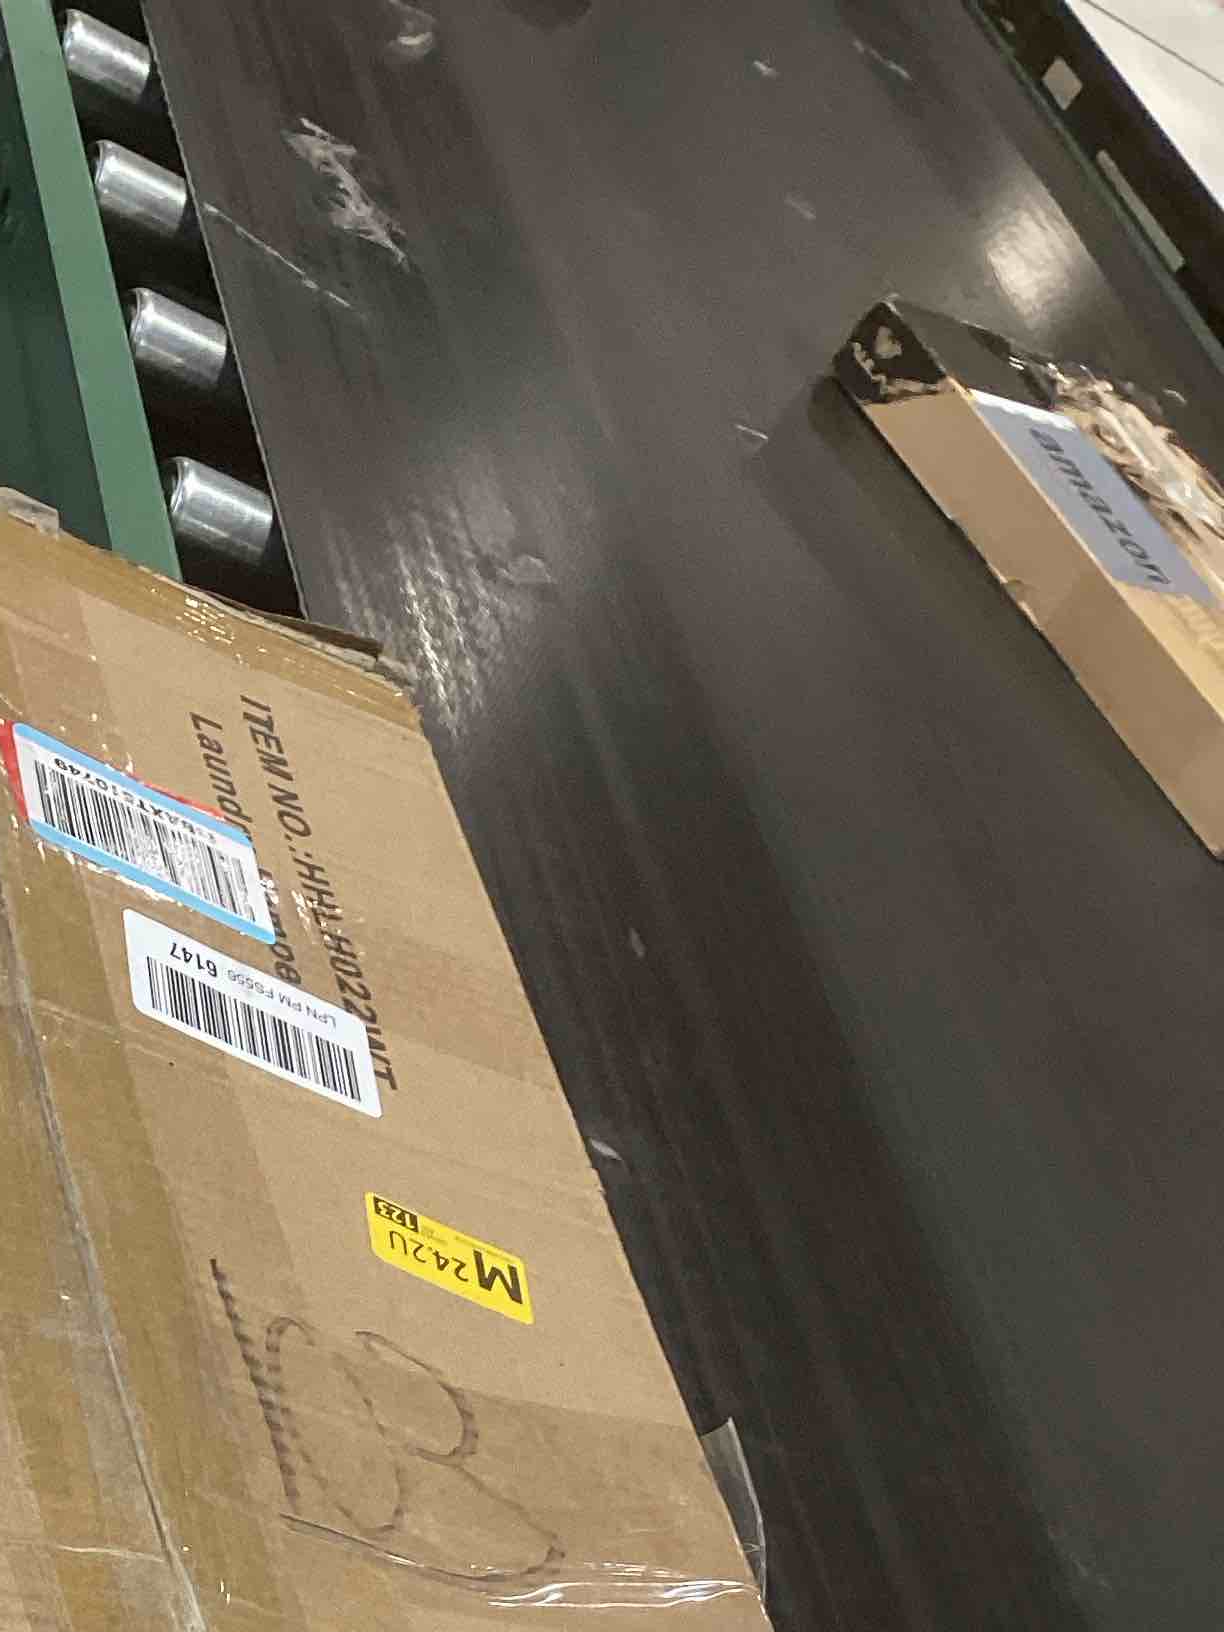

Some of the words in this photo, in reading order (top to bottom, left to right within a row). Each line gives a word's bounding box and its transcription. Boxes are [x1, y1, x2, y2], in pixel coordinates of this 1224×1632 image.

[1031, 430, 1169, 584] amazon
[240, 695, 293, 780] ITEM
[190, 713, 253, 838] Laundr
[169, 942, 218, 977] 6147
[376, 1200, 417, 1231] 123
[389, 1231, 469, 1282] 24.2U
[473, 1249, 523, 1305] M
